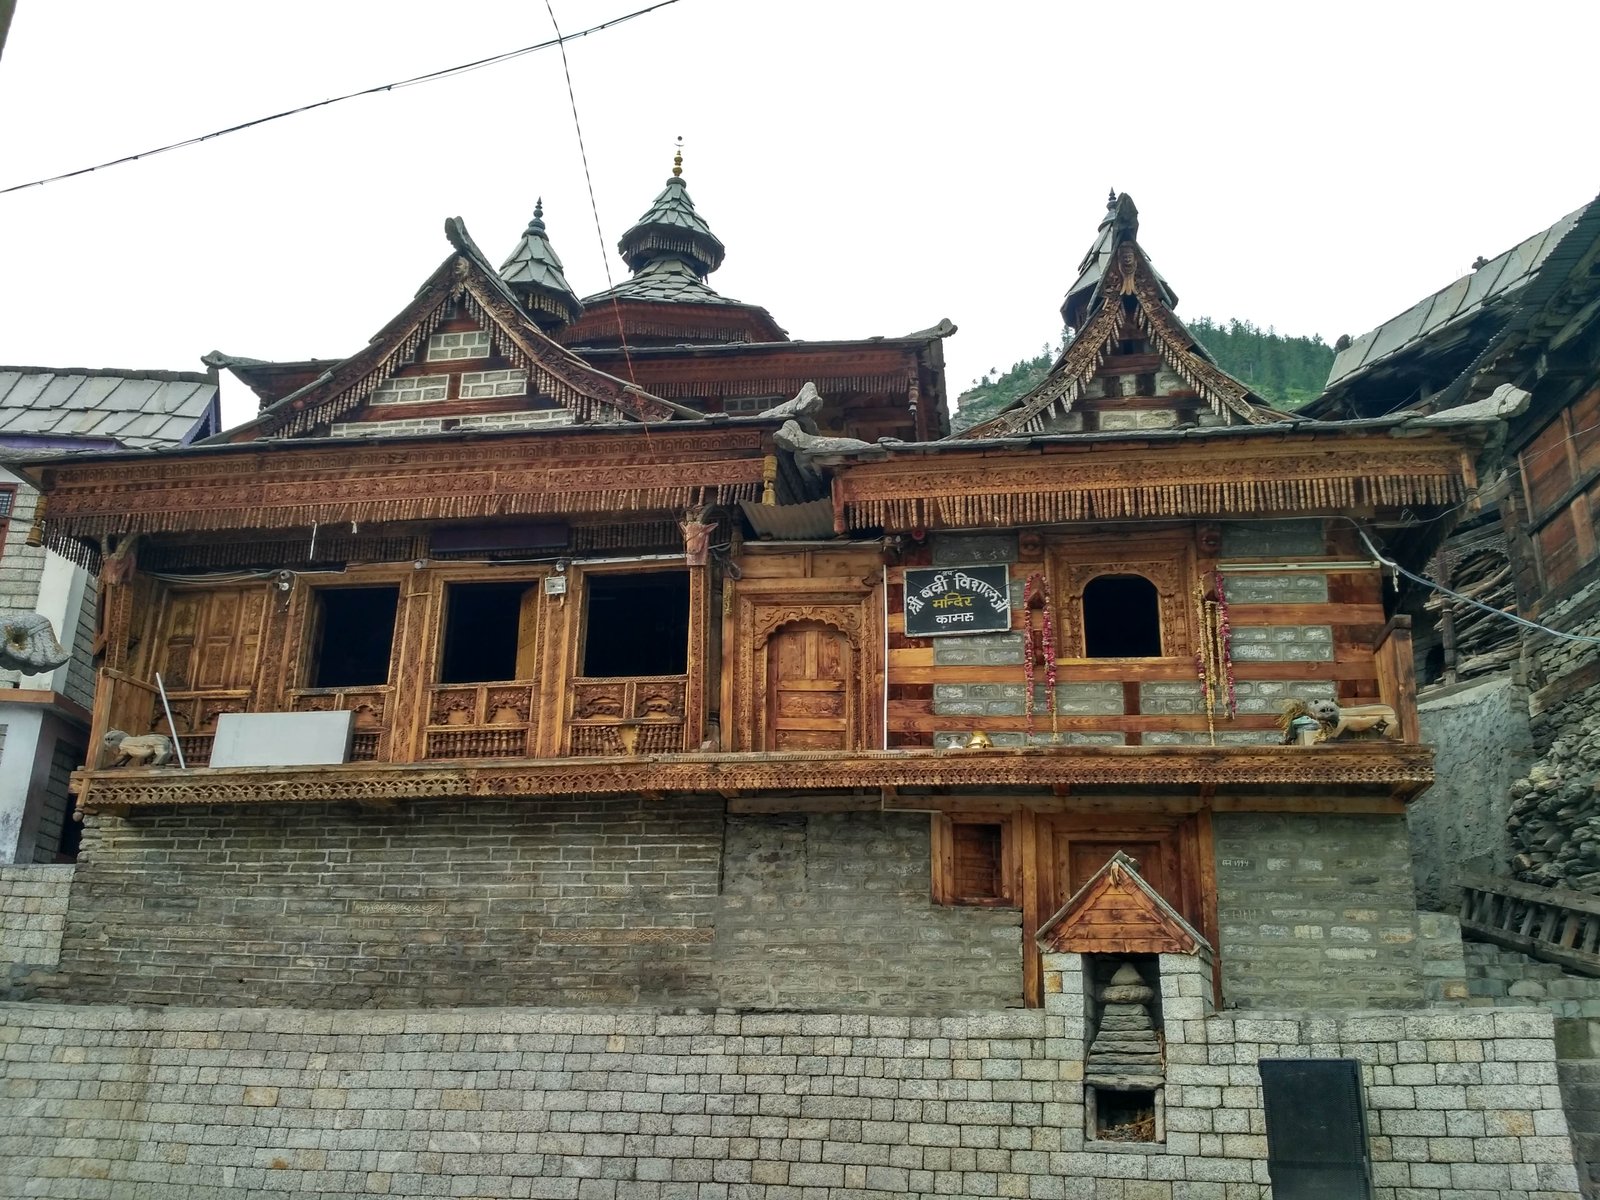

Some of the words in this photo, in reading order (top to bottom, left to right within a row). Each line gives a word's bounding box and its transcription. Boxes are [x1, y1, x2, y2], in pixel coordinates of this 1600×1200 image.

[907, 595, 925, 616] श्री
[920, 575, 949, 598] बद्री
[932, 592, 976, 609] मन्दिर
[935, 612, 975, 625] कामरु
